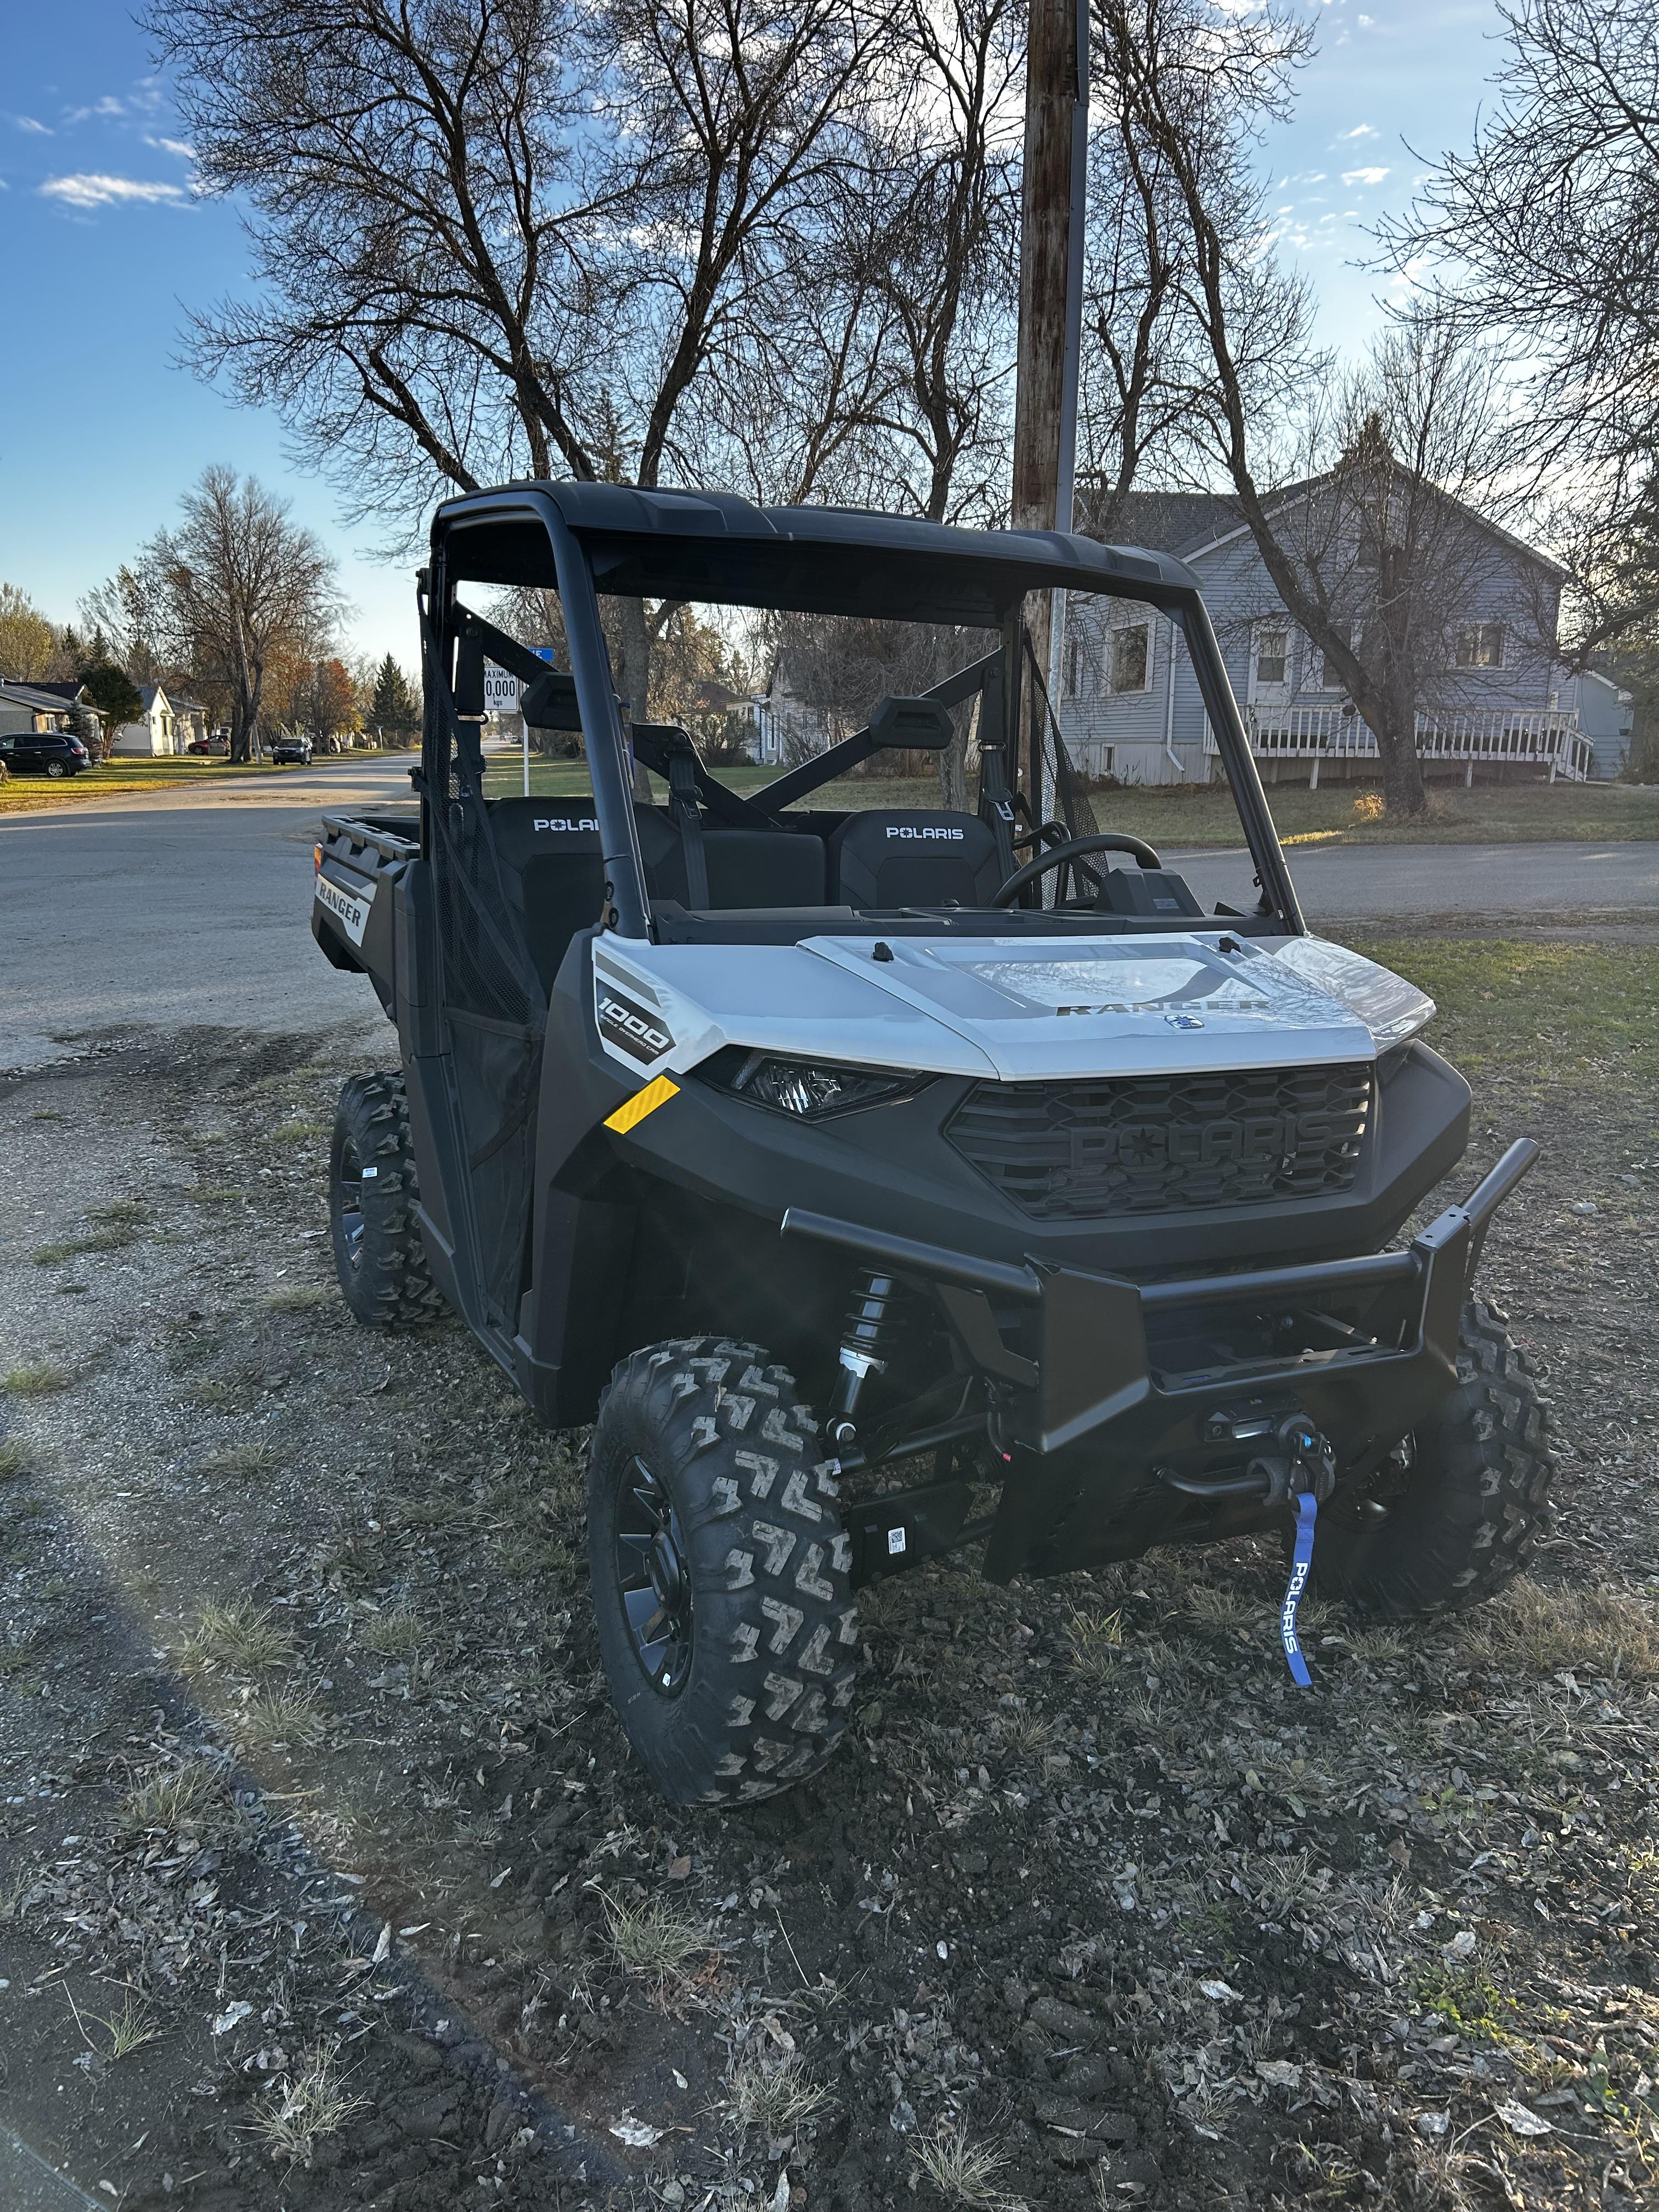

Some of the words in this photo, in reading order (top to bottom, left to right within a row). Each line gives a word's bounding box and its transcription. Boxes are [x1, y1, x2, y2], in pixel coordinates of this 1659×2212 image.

[486, 680, 515, 699] 0,000
[886, 827, 964, 839] POLARIS
[319, 882, 362, 927] RANGER
[598, 997, 669, 1049] 1000
[1056, 1000, 1270, 1017] RANGER
[1070, 1113, 1332, 1170] POLARIS
[1283, 1562, 1308, 1654] POLARIS
